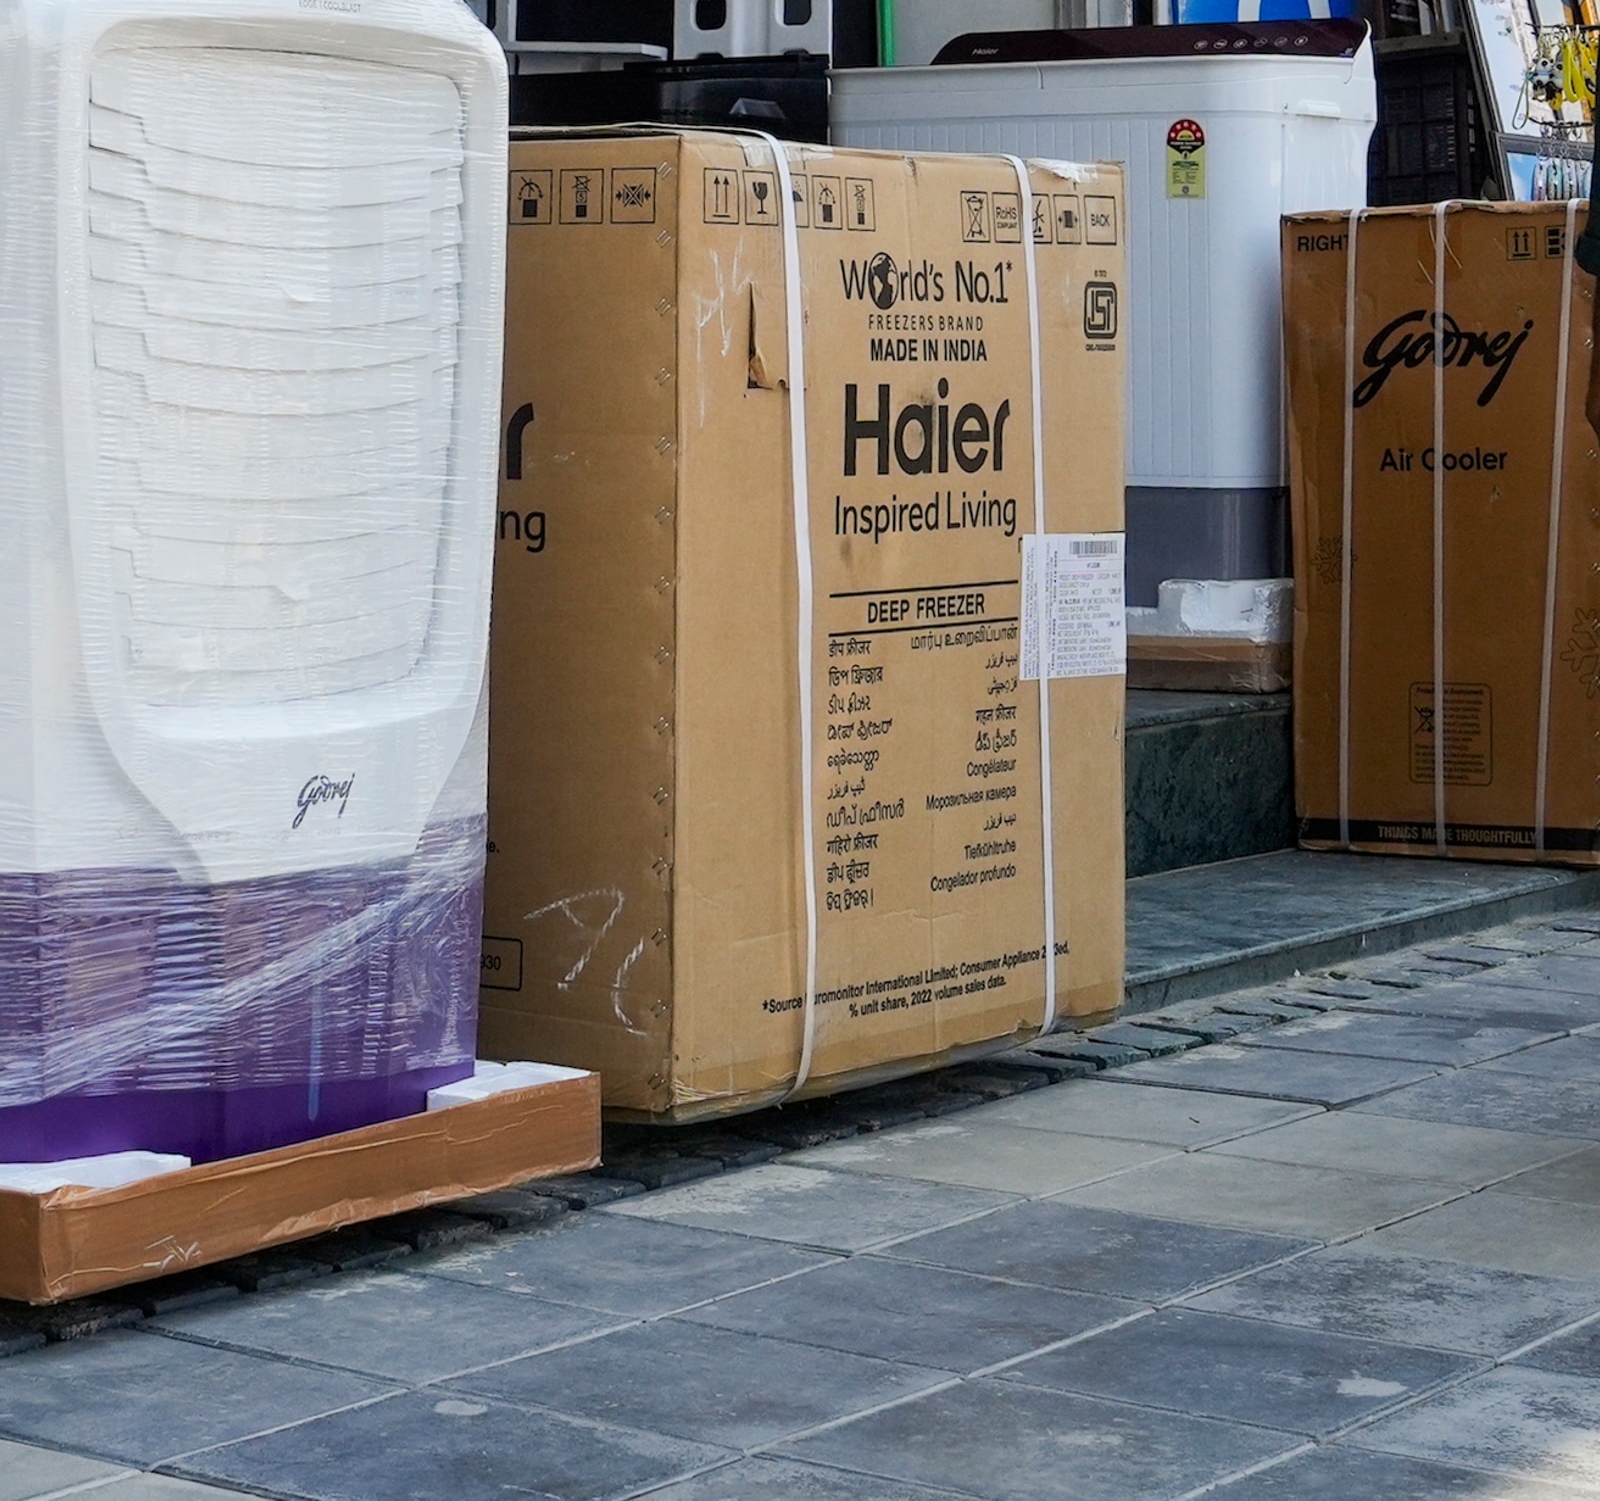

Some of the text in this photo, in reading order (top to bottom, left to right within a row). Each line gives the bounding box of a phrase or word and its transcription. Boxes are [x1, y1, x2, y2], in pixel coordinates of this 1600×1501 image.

[995, 206, 1017, 221] RoHS
[1090, 213, 1110, 228] BACK
[869, 314, 984, 332] FREEZERS BRAND
[870, 339, 988, 362] MADE IN INDIA
[1352, 309, 1534, 409] Godrej
[843, 377, 1011, 477] Haier
[1380, 448, 1508, 472] Air Cooler
[835, 489, 1017, 544] Inspired Living
[867, 593, 986, 624] DEEP FREEZER
[966, 758, 1017, 779] Congélateur
[292, 772, 355, 830] Godrej
[926, 785, 1017, 812] Морозильная камера
[930, 862, 1017, 893] Congelador profundo
[805, 984, 864, 1009] uromonitor
[865, 974, 924, 997] International
[959, 957, 1001, 977] Consumer
[1001, 951, 1041, 970] Appliance
[849, 973, 1008, 1019] % unit share, 2022 volume sales data.
